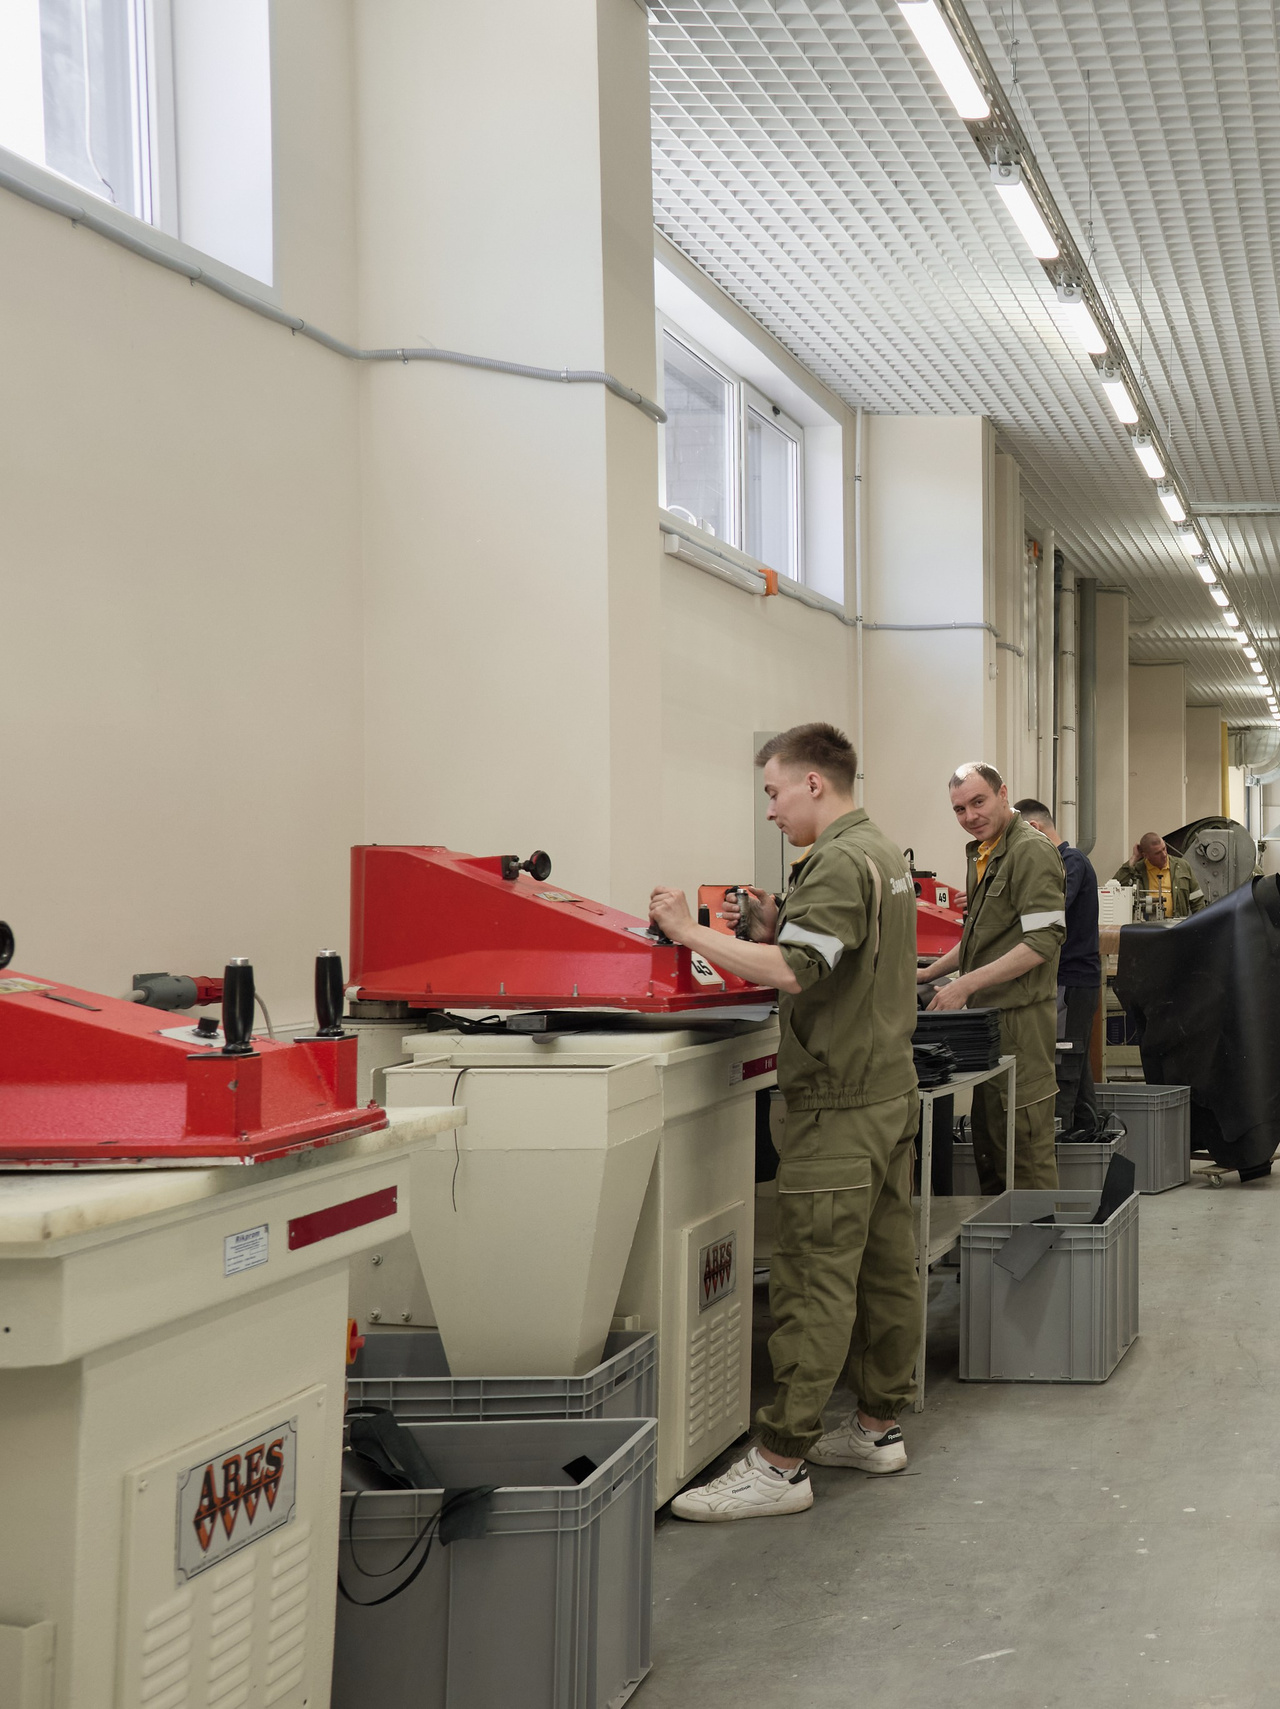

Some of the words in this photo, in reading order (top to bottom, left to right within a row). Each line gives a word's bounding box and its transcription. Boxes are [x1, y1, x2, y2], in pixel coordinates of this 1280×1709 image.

[938, 892, 947, 903] 49
[691, 959, 713, 976] 45
[193, 1436, 286, 1524] ARES
